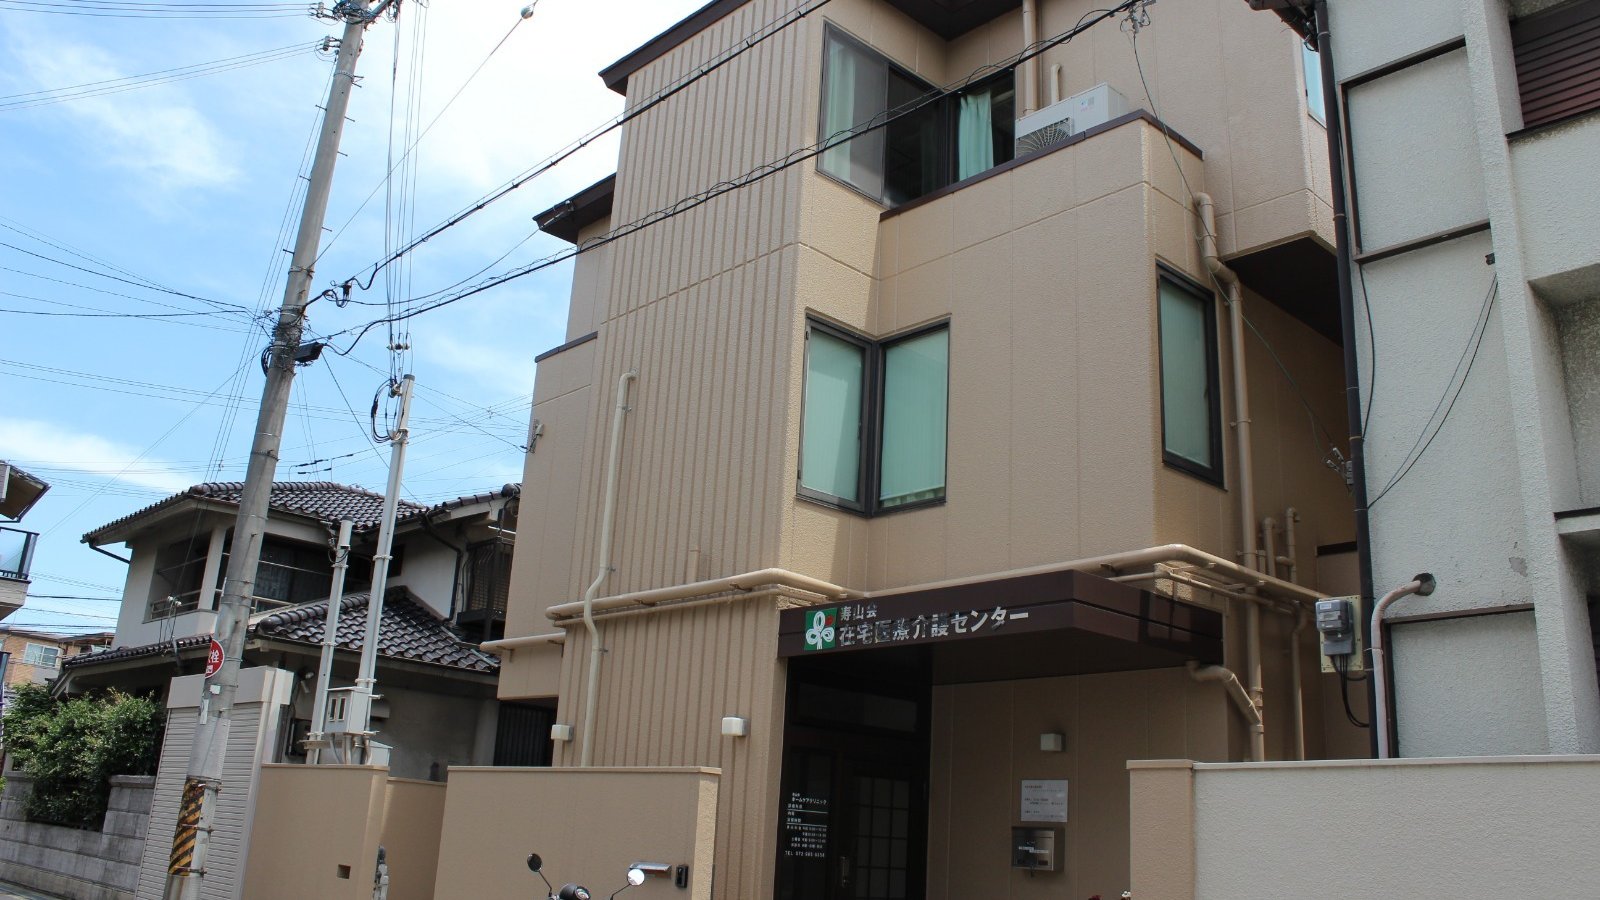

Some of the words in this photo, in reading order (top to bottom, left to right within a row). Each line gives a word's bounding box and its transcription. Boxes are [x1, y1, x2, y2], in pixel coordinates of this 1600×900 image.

[839, 606, 1028, 646] 在宅医療介護センター
[840, 604, 877, 621] 寿山会
